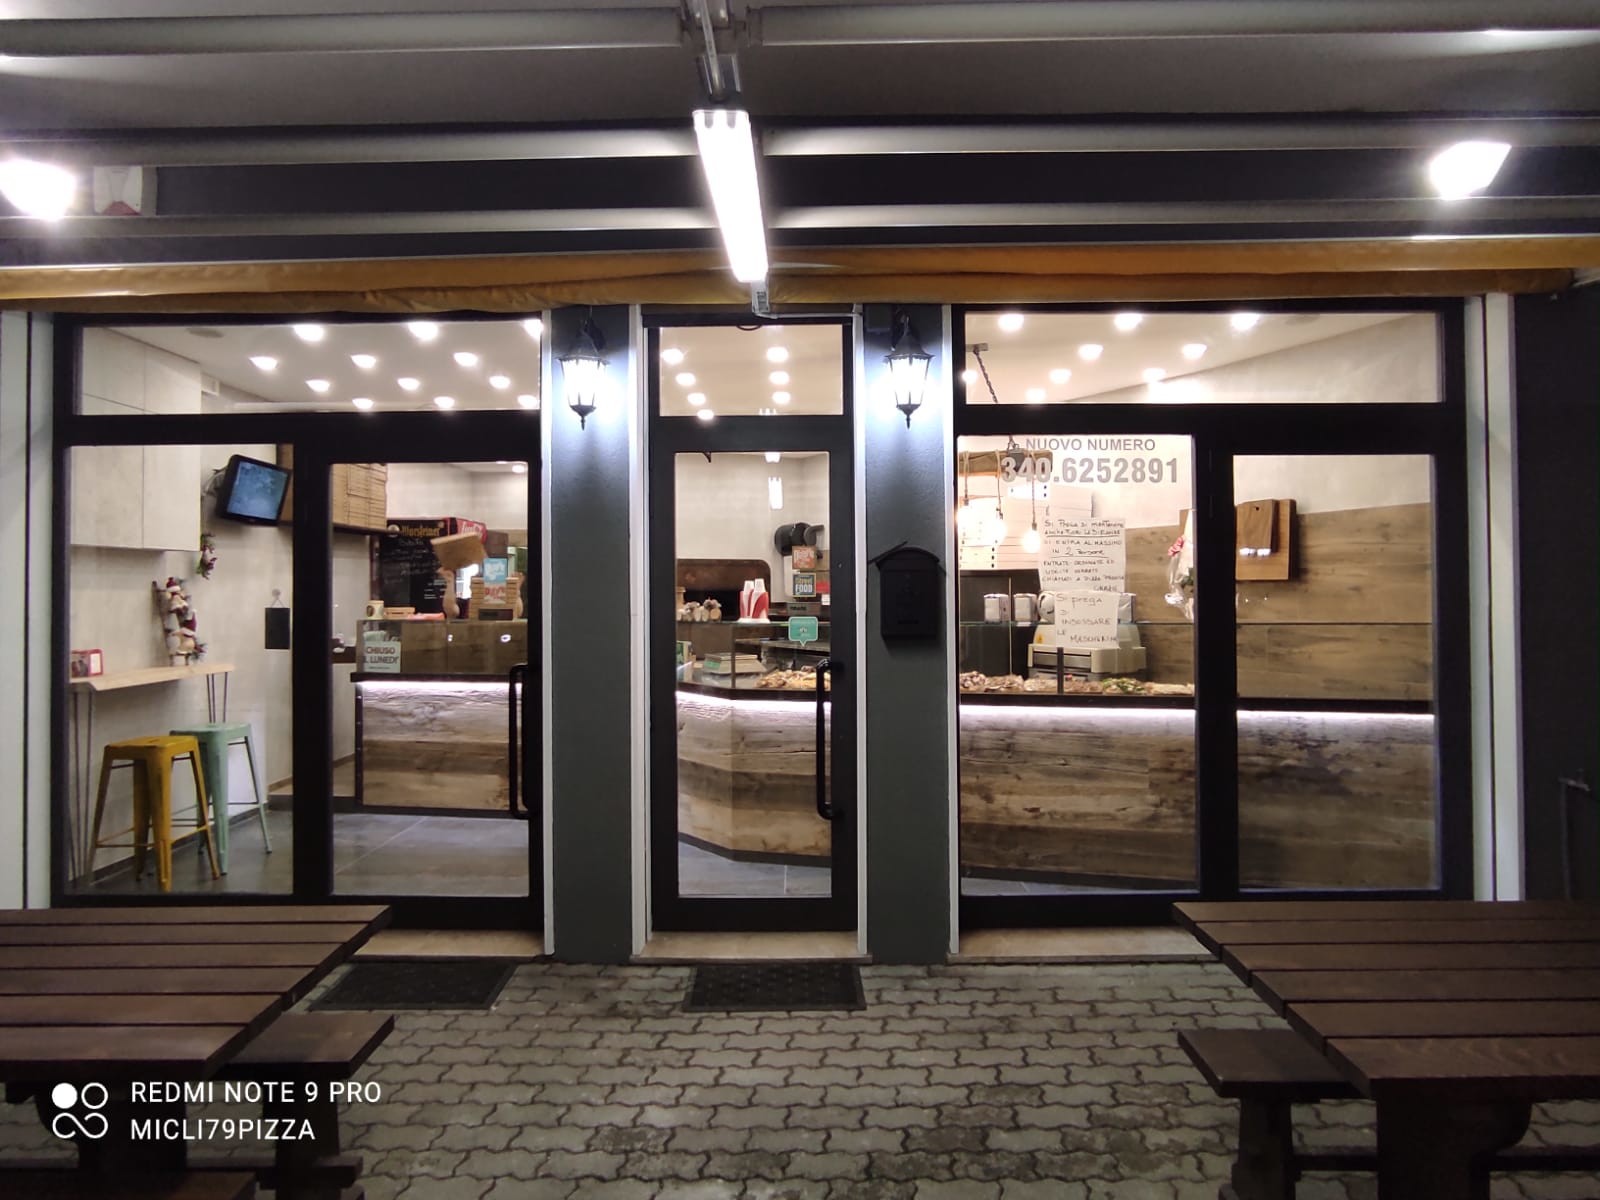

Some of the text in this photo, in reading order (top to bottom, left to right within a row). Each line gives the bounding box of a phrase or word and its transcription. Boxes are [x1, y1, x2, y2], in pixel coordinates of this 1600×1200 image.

[1026, 438, 1156, 451] NUOVO NUMERO
[1001, 457, 1178, 483] 340.6252891
[795, 583, 813, 593] FOOD
[366, 646, 395, 655] CHIUSO
